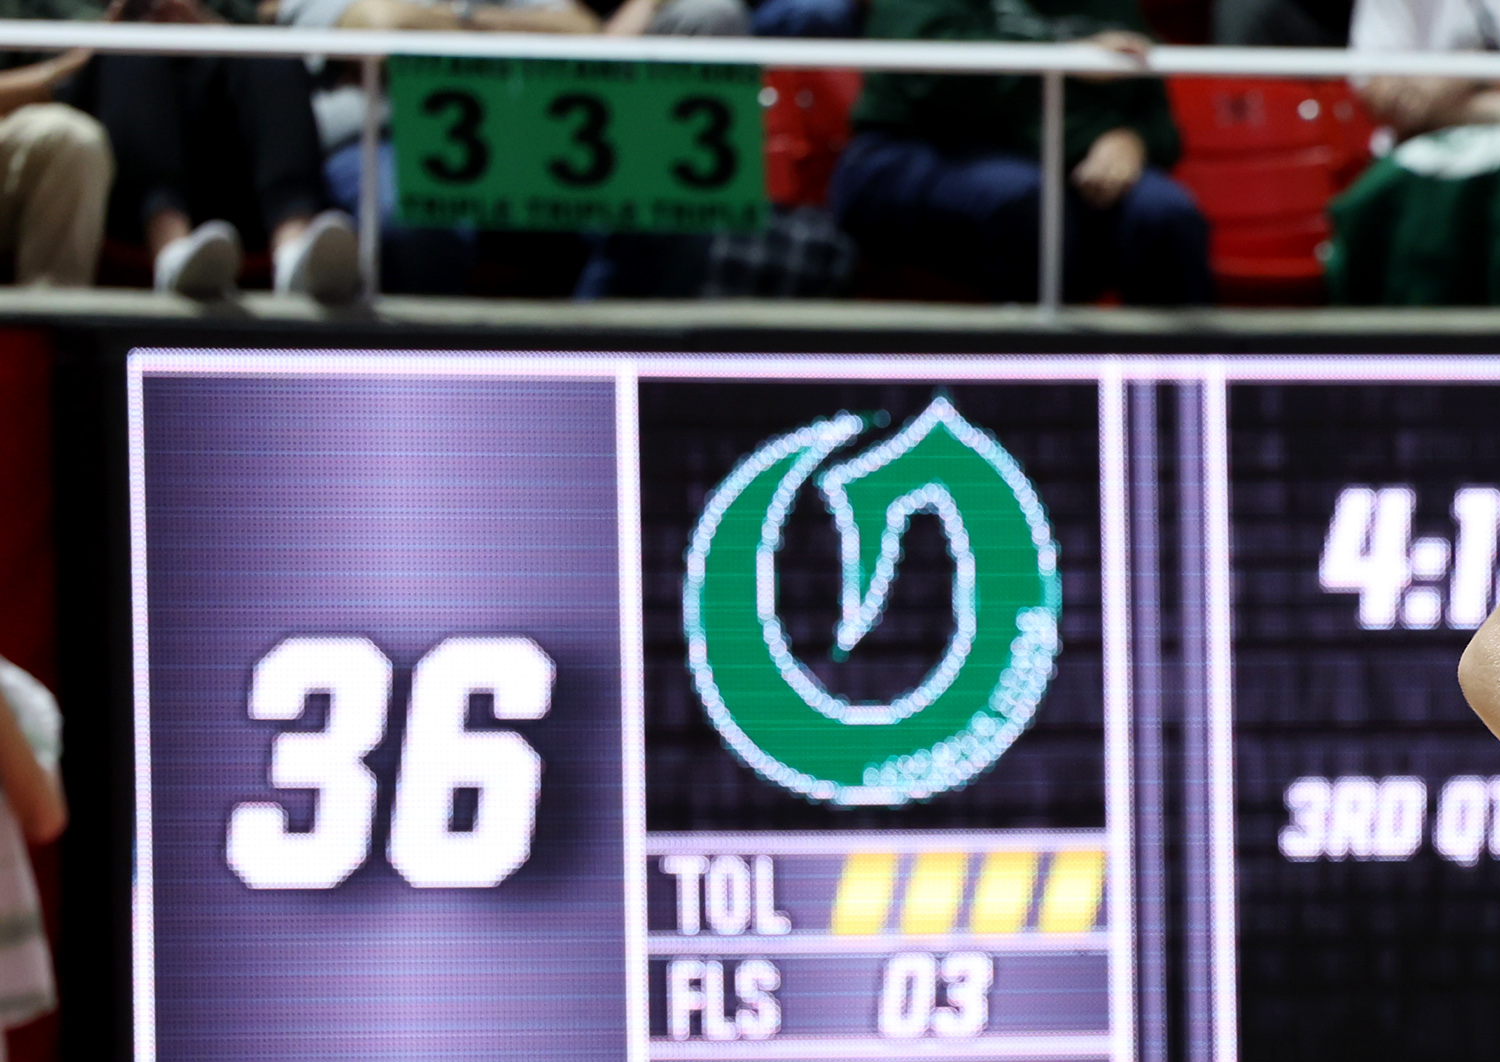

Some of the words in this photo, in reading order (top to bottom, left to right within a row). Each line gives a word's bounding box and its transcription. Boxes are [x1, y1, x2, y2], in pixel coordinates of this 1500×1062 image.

[420, 88, 491, 184] 3
[545, 91, 617, 188] 3
[670, 94, 739, 191] 3
[226, 634, 556, 889] 36
[1278, 775, 1427, 861] 3RD
[659, 854, 792, 936] TOL
[667, 955, 782, 1041] FLS
[877, 950, 994, 1038] 03
